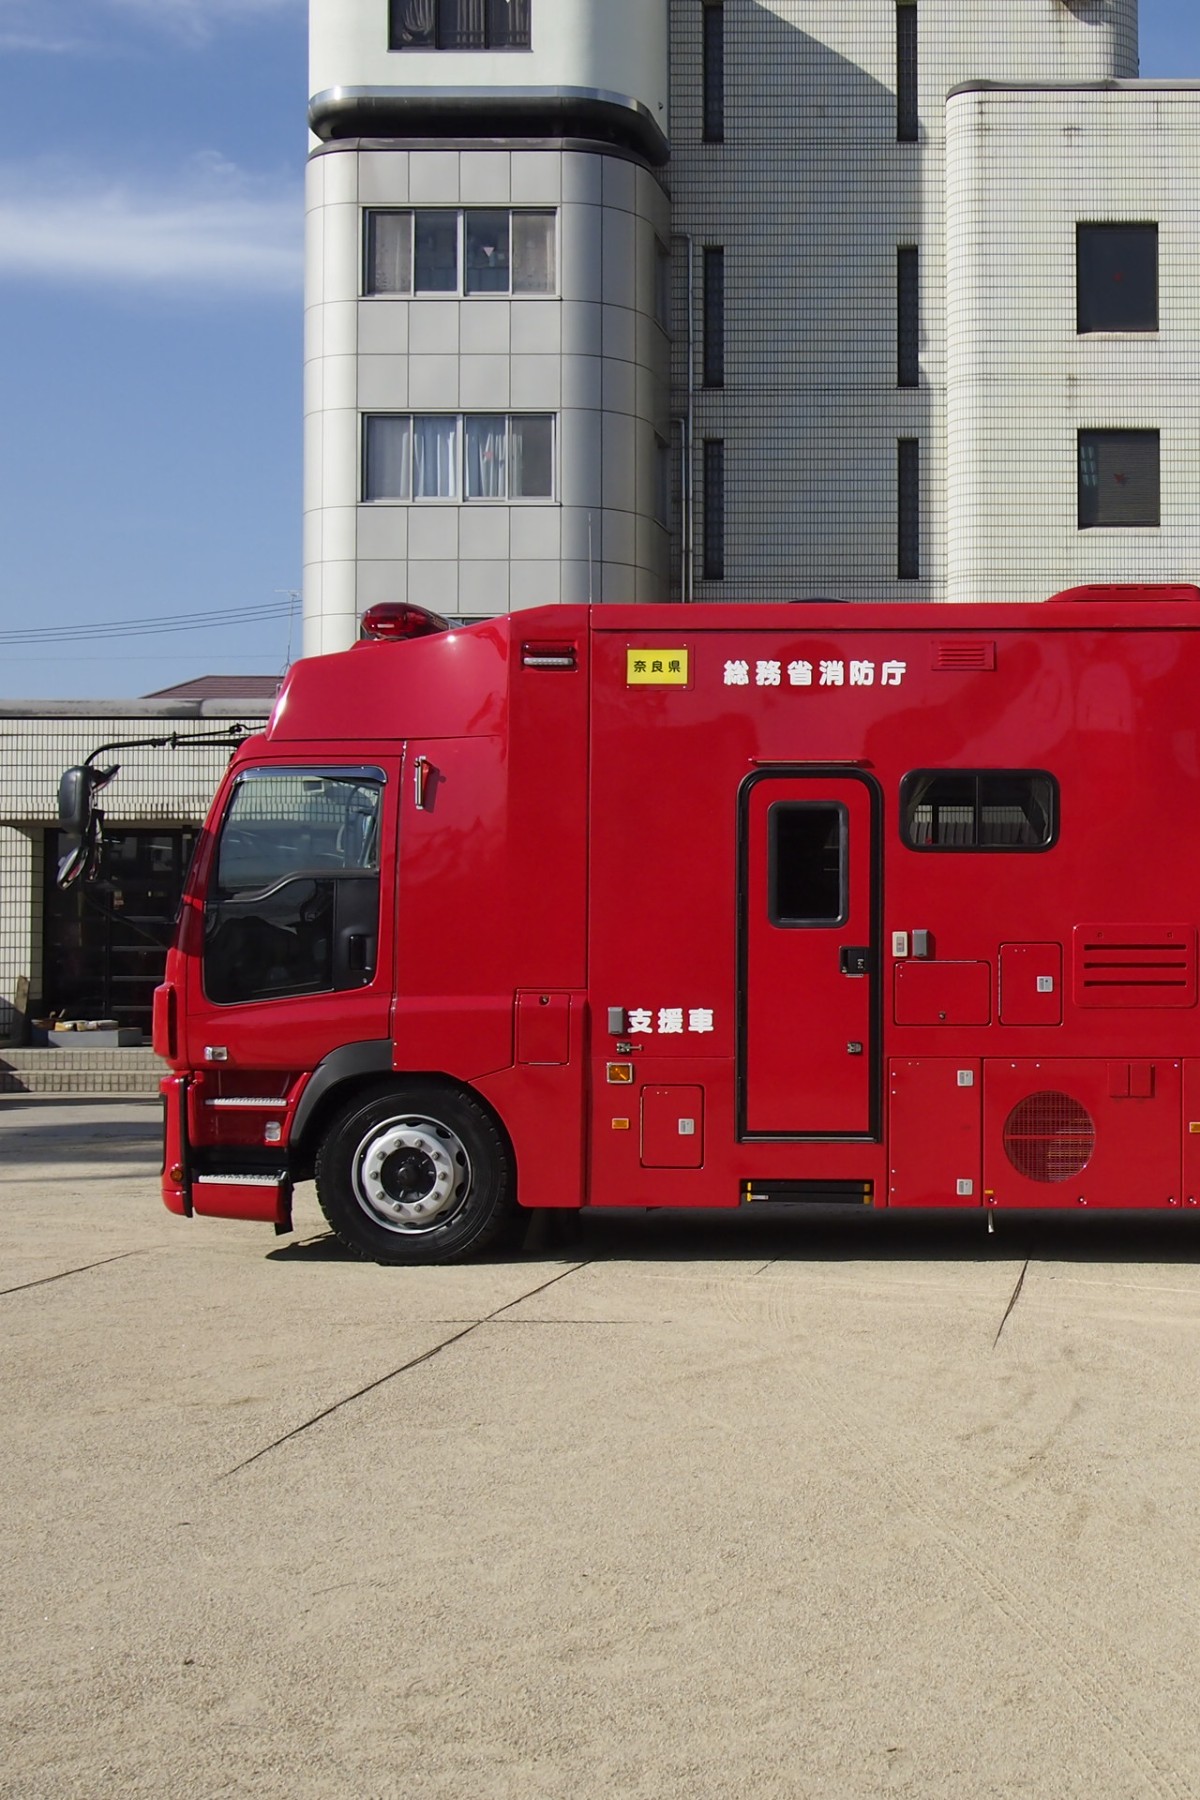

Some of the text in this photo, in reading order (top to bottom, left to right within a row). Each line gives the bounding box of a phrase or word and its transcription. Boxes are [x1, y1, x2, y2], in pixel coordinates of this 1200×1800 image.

[633, 660, 682, 673] 奈良県
[723, 659, 907, 686] 総務省消防庁
[627, 1007, 715, 1034] 支援車
